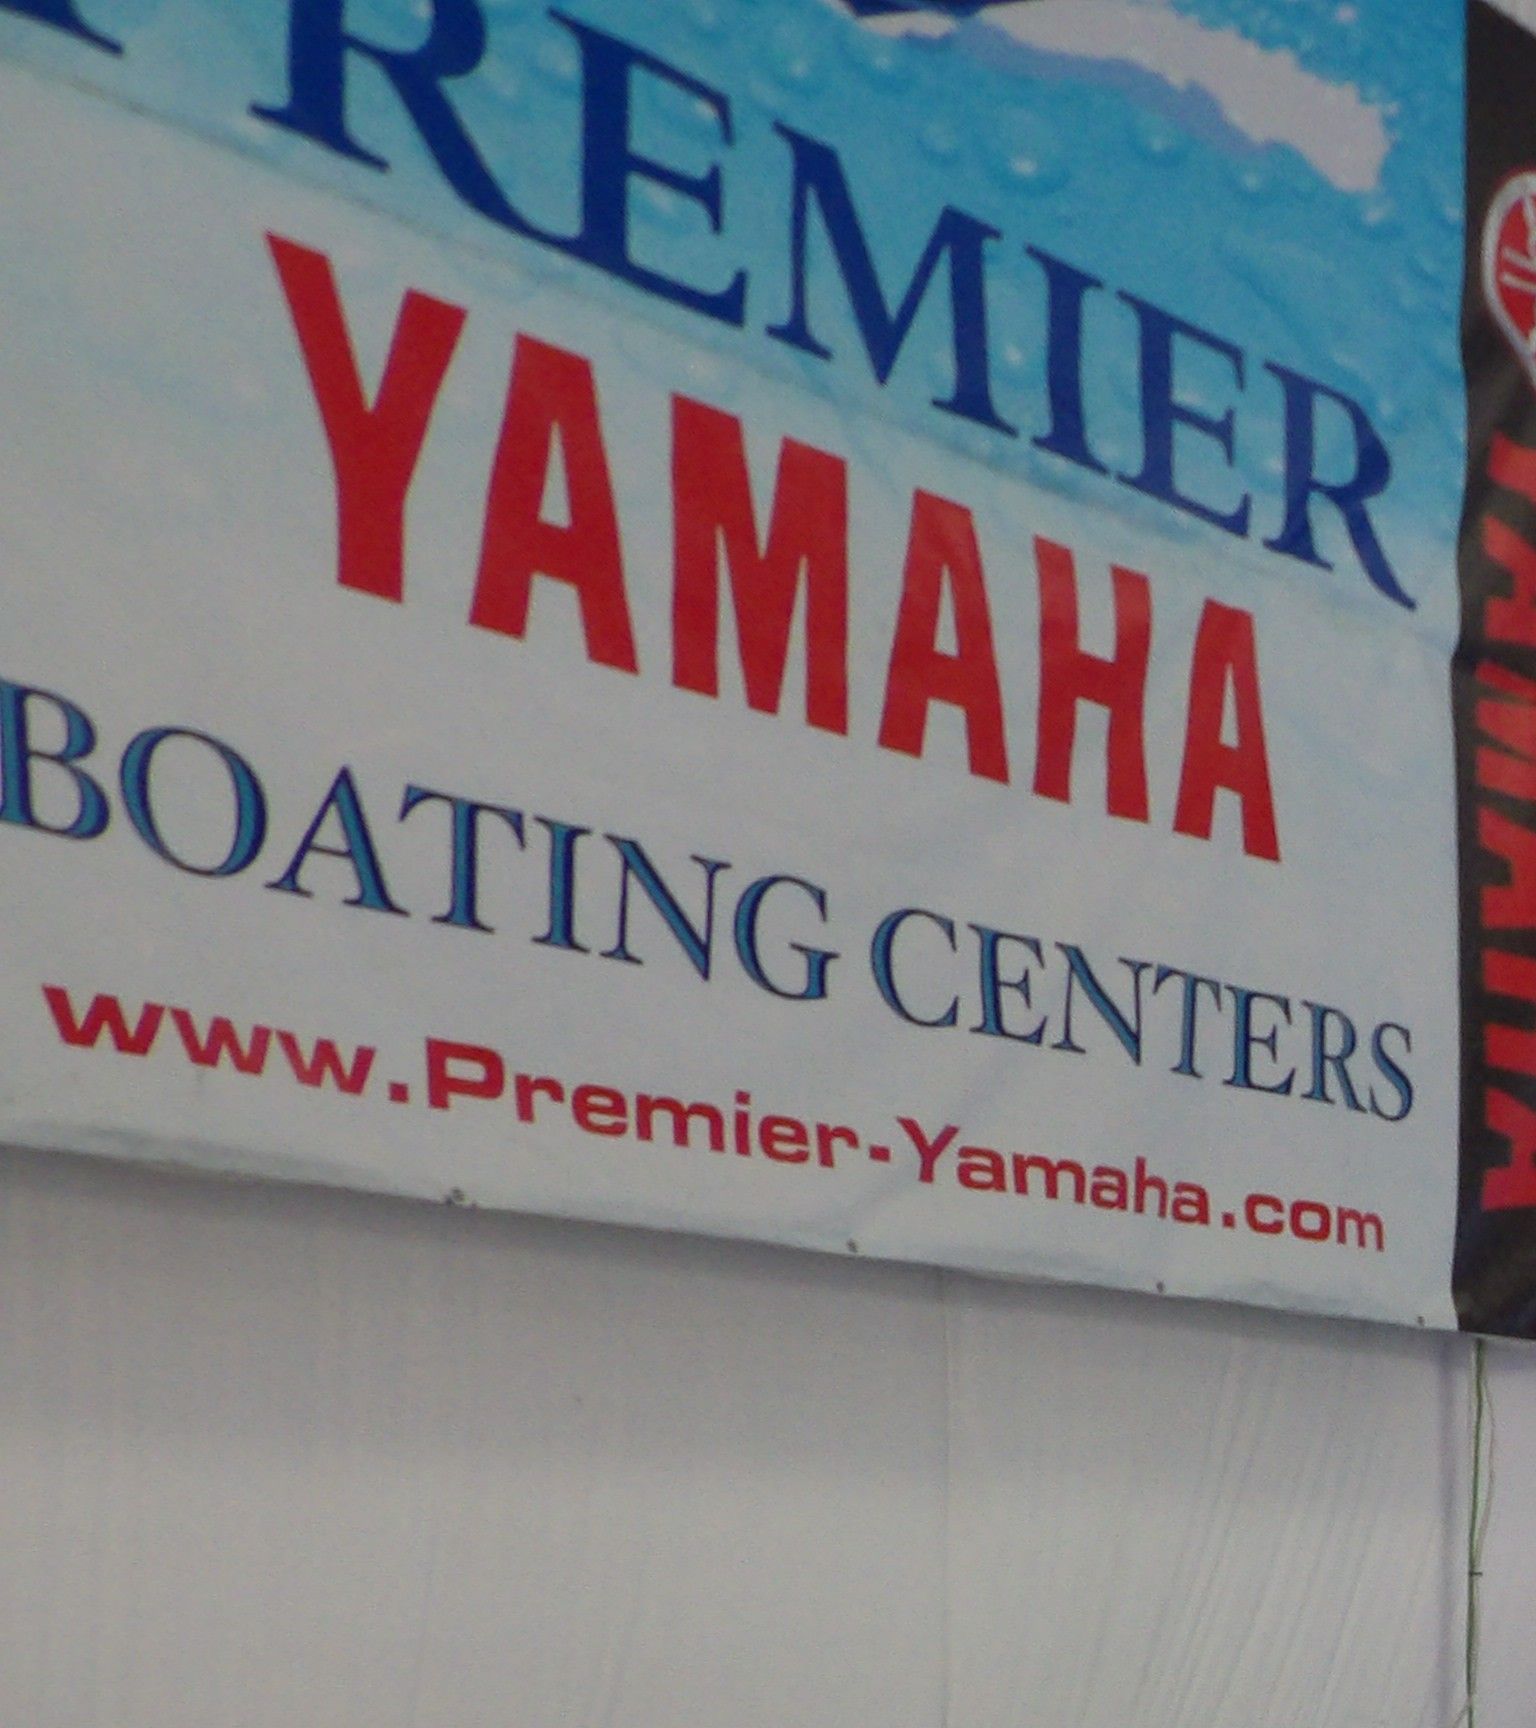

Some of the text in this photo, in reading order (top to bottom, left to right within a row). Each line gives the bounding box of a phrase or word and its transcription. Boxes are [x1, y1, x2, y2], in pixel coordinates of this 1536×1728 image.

[0, 0, 1416, 611] REMIER
[264, 229, 1280, 862] YAMAHA
[0, 677, 1416, 1122] BOATING CENTERS
[41, 984, 1386, 1252] www.Premier-Yamaha.com
